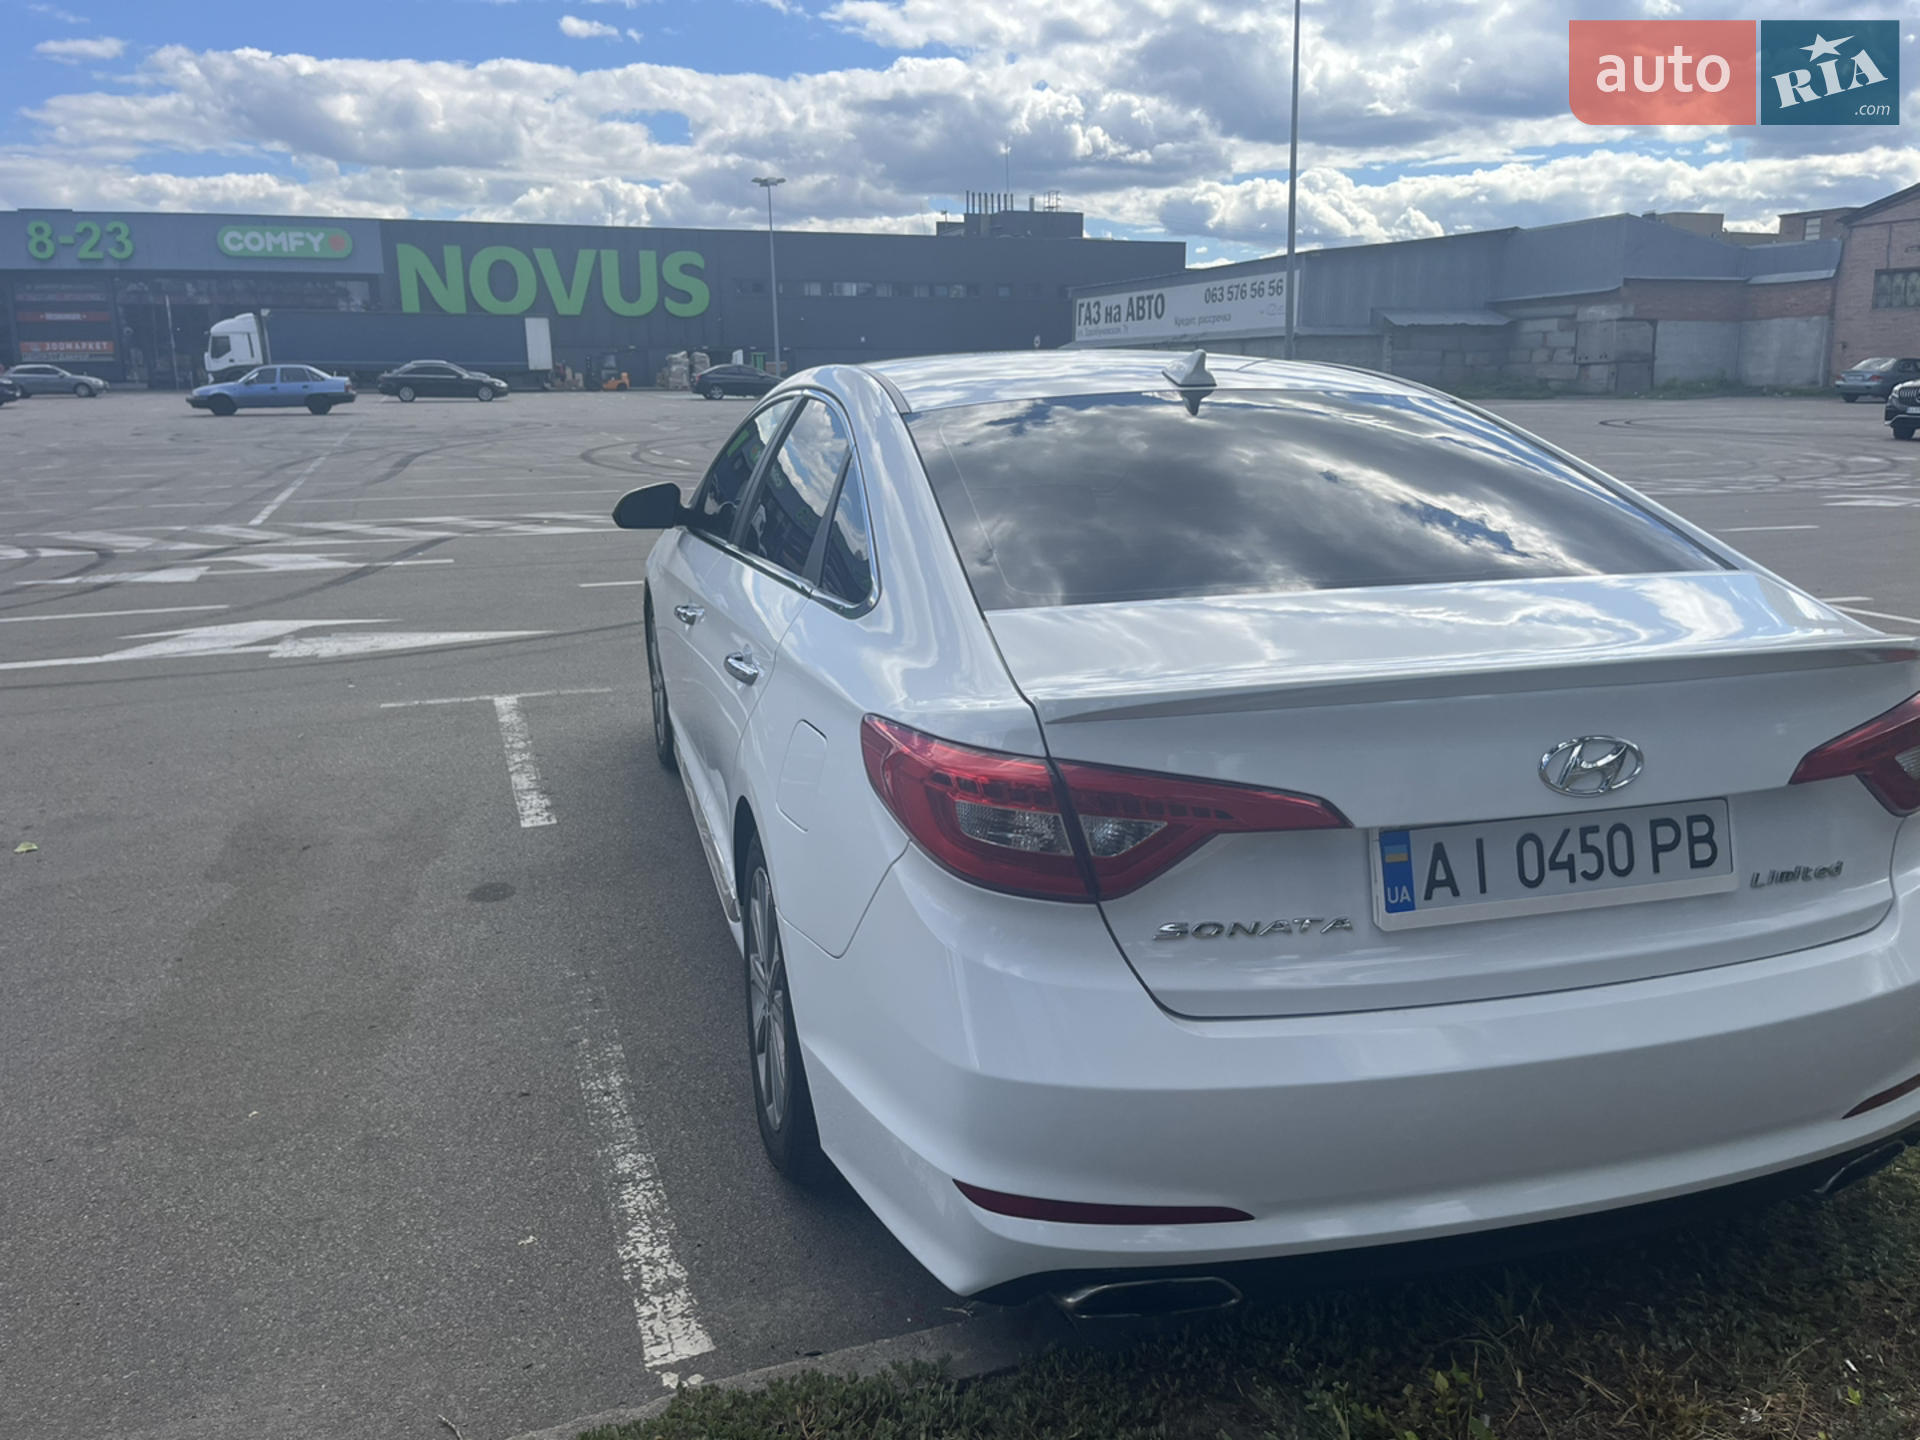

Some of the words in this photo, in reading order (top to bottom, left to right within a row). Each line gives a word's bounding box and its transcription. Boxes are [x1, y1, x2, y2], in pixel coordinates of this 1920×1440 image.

[28, 220, 134, 260] 8-23
[223, 230, 325, 252] COMFY
[396, 243, 711, 317] NOVUS
[1204, 286, 1224, 304] 063
[1227, 282, 1247, 302] 576
[1250, 281, 1265, 298] 56
[1268, 278, 1284, 297] 56
[1077, 301, 1101, 326] ГАЗ
[1105, 304, 1121, 324] на
[1125, 293, 1165, 322] АВТО
[1516, 822, 1634, 889] 0450
[1649, 814, 1718, 874] PB
[1750, 861, 1844, 888] Limited
[1386, 887, 1412, 904] UA
[1152, 916, 1354, 940] SONATA
